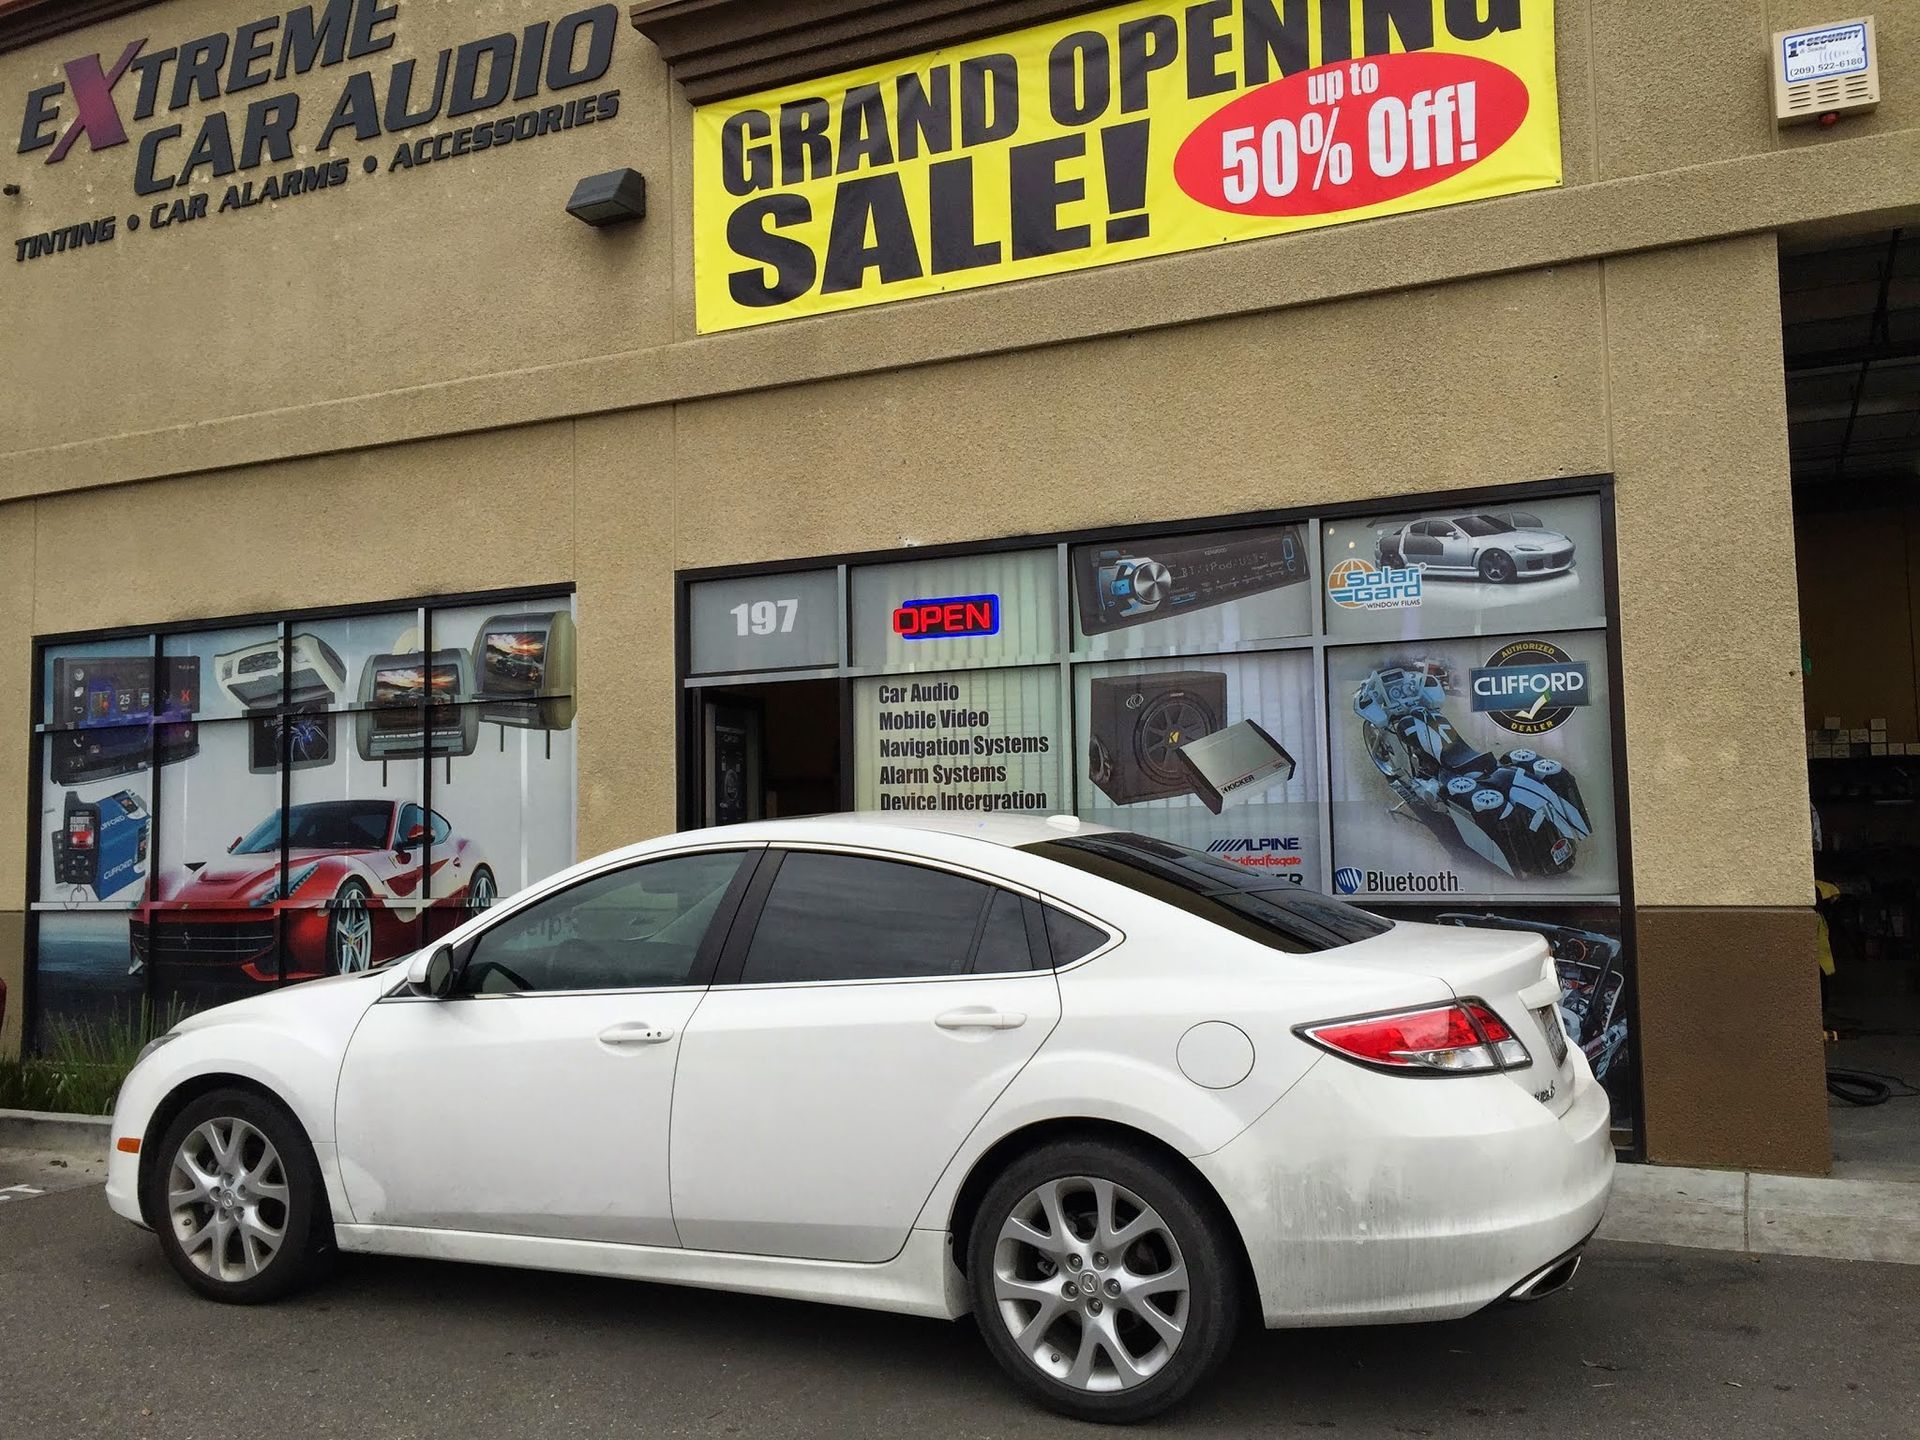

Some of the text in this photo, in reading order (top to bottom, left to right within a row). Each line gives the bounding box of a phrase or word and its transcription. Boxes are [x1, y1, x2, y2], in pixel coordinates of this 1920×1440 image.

[1790, 57, 1863, 77] (209) 522-6180
[1307, 62, 1379, 106] up to
[133, 4, 619, 196] CAR AUDIO
[720, 53, 1020, 198] GRAND
[1221, 81, 1478, 206] 50% Off!
[15, 89, 622, 263] TINTING CAR ALARMS ACCESSORIES
[726, 117, 1151, 309] SALE!
[1346, 567, 1419, 587] Solar
[1354, 574, 1421, 602] Gard
[1366, 598, 1420, 609] WINDOW FILMS
[730, 598, 799, 637] 197
[893, 602, 991, 636] OPEN
[1501, 642, 1555, 658] AUTHORIZED
[878, 682, 960, 705] Car Audio
[1473, 671, 1584, 697] CLIFFORD
[879, 708, 990, 731] Mobile Video
[1511, 720, 1554, 733] DEALER
[879, 734, 1050, 759] Navigation Systems
[879, 763, 1008, 785] Alarm Systems
[880, 790, 1048, 813] Device Intergration
[1234, 837, 1302, 851] ALPINE
[1366, 870, 1459, 893] Bluetooth
